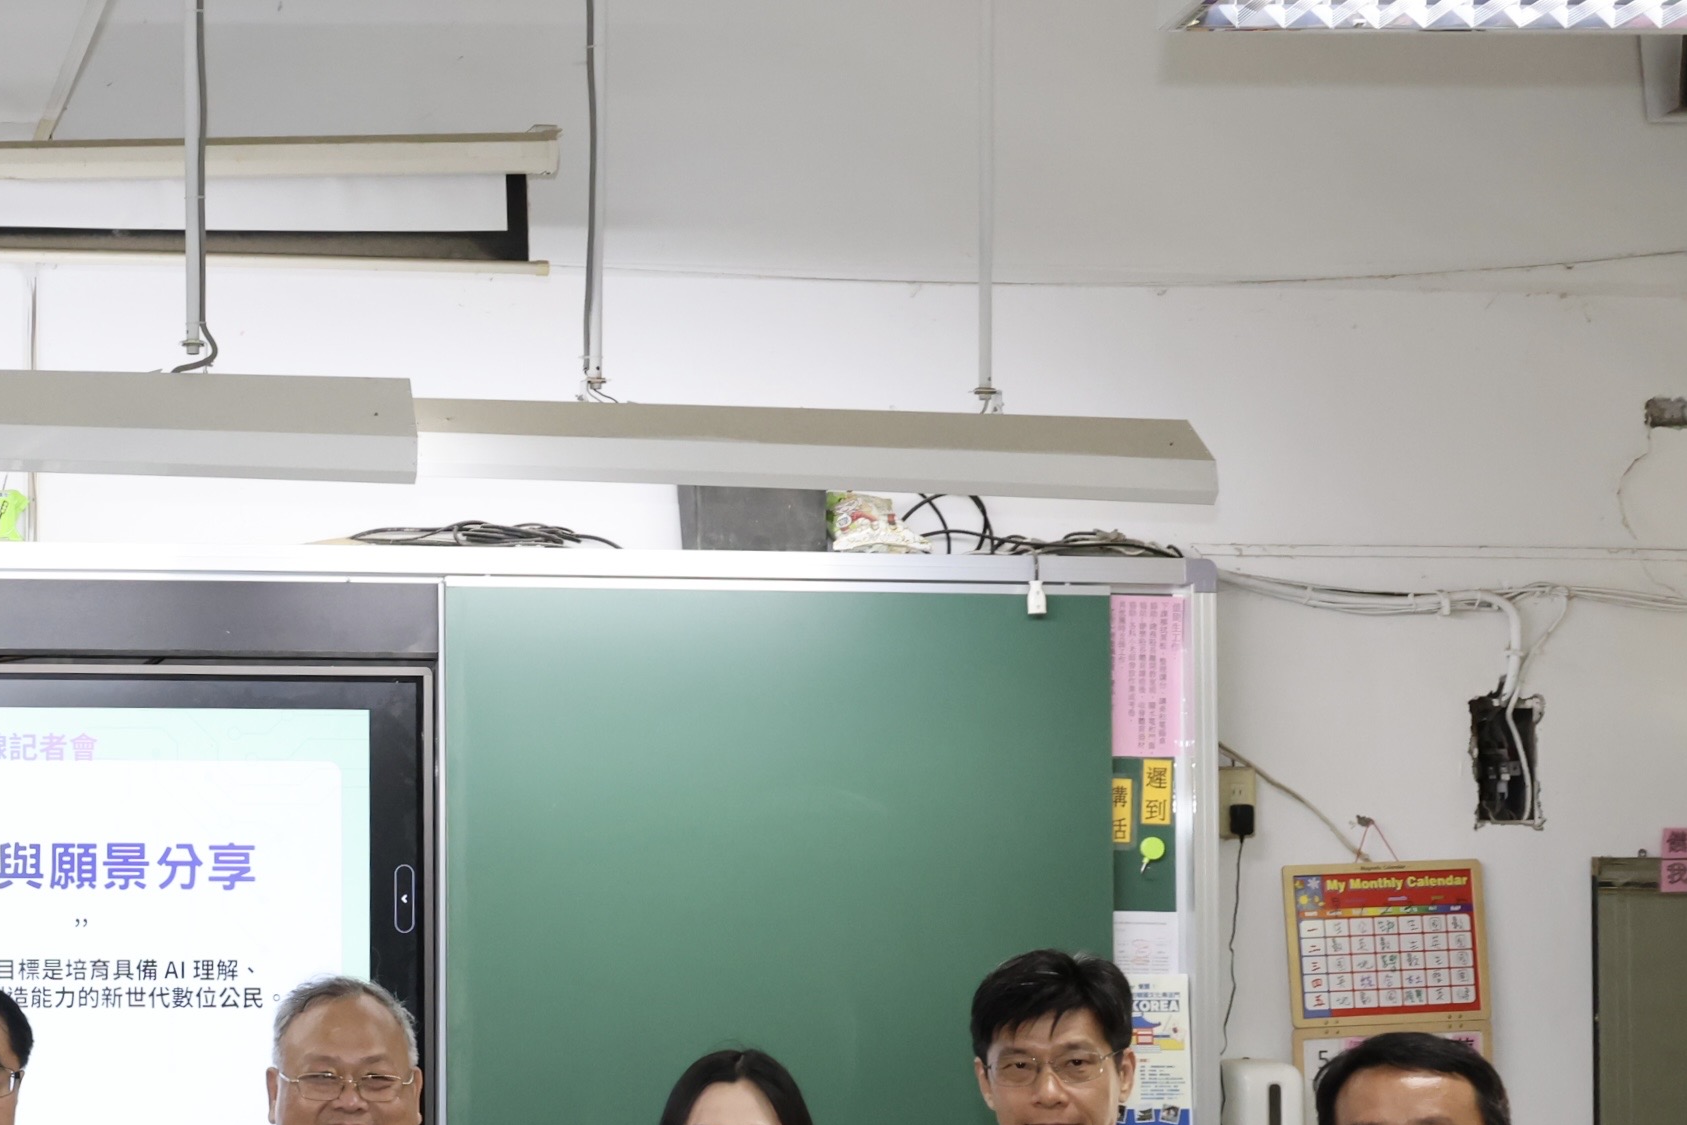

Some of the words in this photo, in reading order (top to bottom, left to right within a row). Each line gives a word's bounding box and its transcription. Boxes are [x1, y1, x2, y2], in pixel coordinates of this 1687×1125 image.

[1145, 767, 1168, 821] 遲到
[1326, 879, 1346, 893] My
[1350, 877, 1403, 891] Monthly
[1407, 875, 1468, 888] Calendar
[164, 961, 186, 979] AI
[193, 958, 255, 981] 理解、
[1, 986, 281, 1009] 造能力的新世代數位公民。
